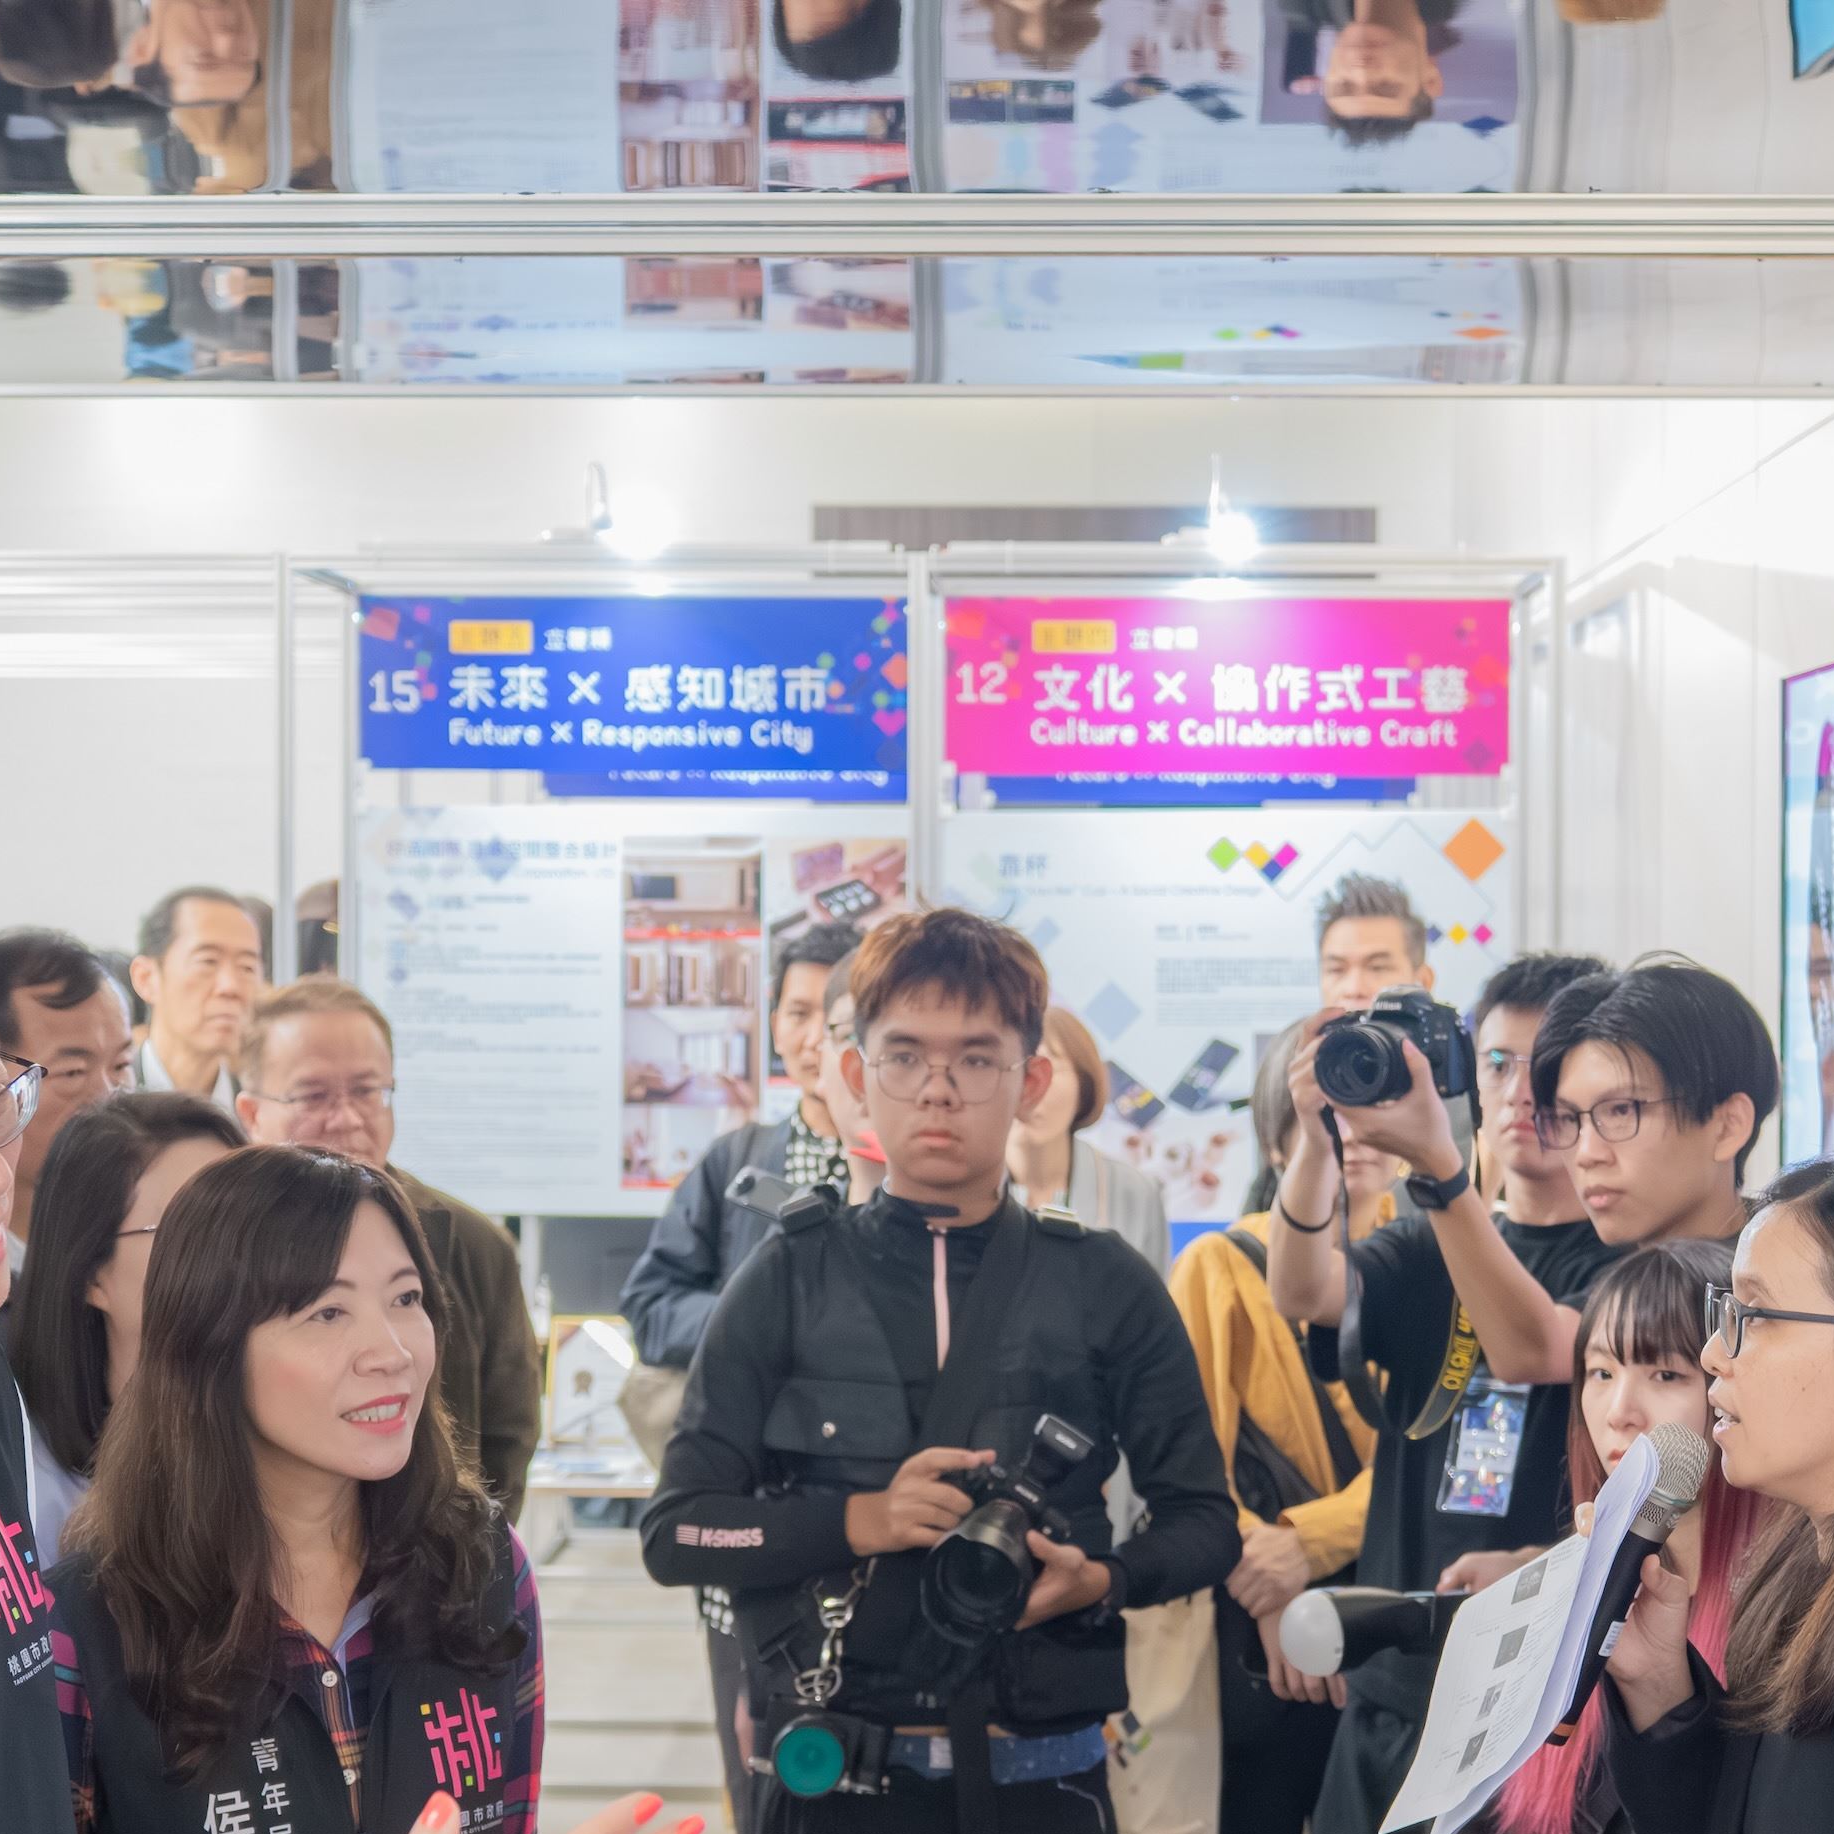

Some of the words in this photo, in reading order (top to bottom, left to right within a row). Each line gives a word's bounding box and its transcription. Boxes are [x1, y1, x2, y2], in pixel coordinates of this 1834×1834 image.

[368, 669, 422, 713] 15
[448, 663, 549, 712] 未來
[624, 664, 828, 713] 感知城市
[955, 661, 1008, 704] 12
[1033, 663, 1134, 712] 文化
[448, 716, 543, 746] Future
[581, 717, 742, 753] Responsive
[750, 718, 815, 755] City
[1030, 716, 1139, 746] Culture
[1177, 716, 1371, 747] Collaborative
[1379, 718, 1458, 747] Craft
